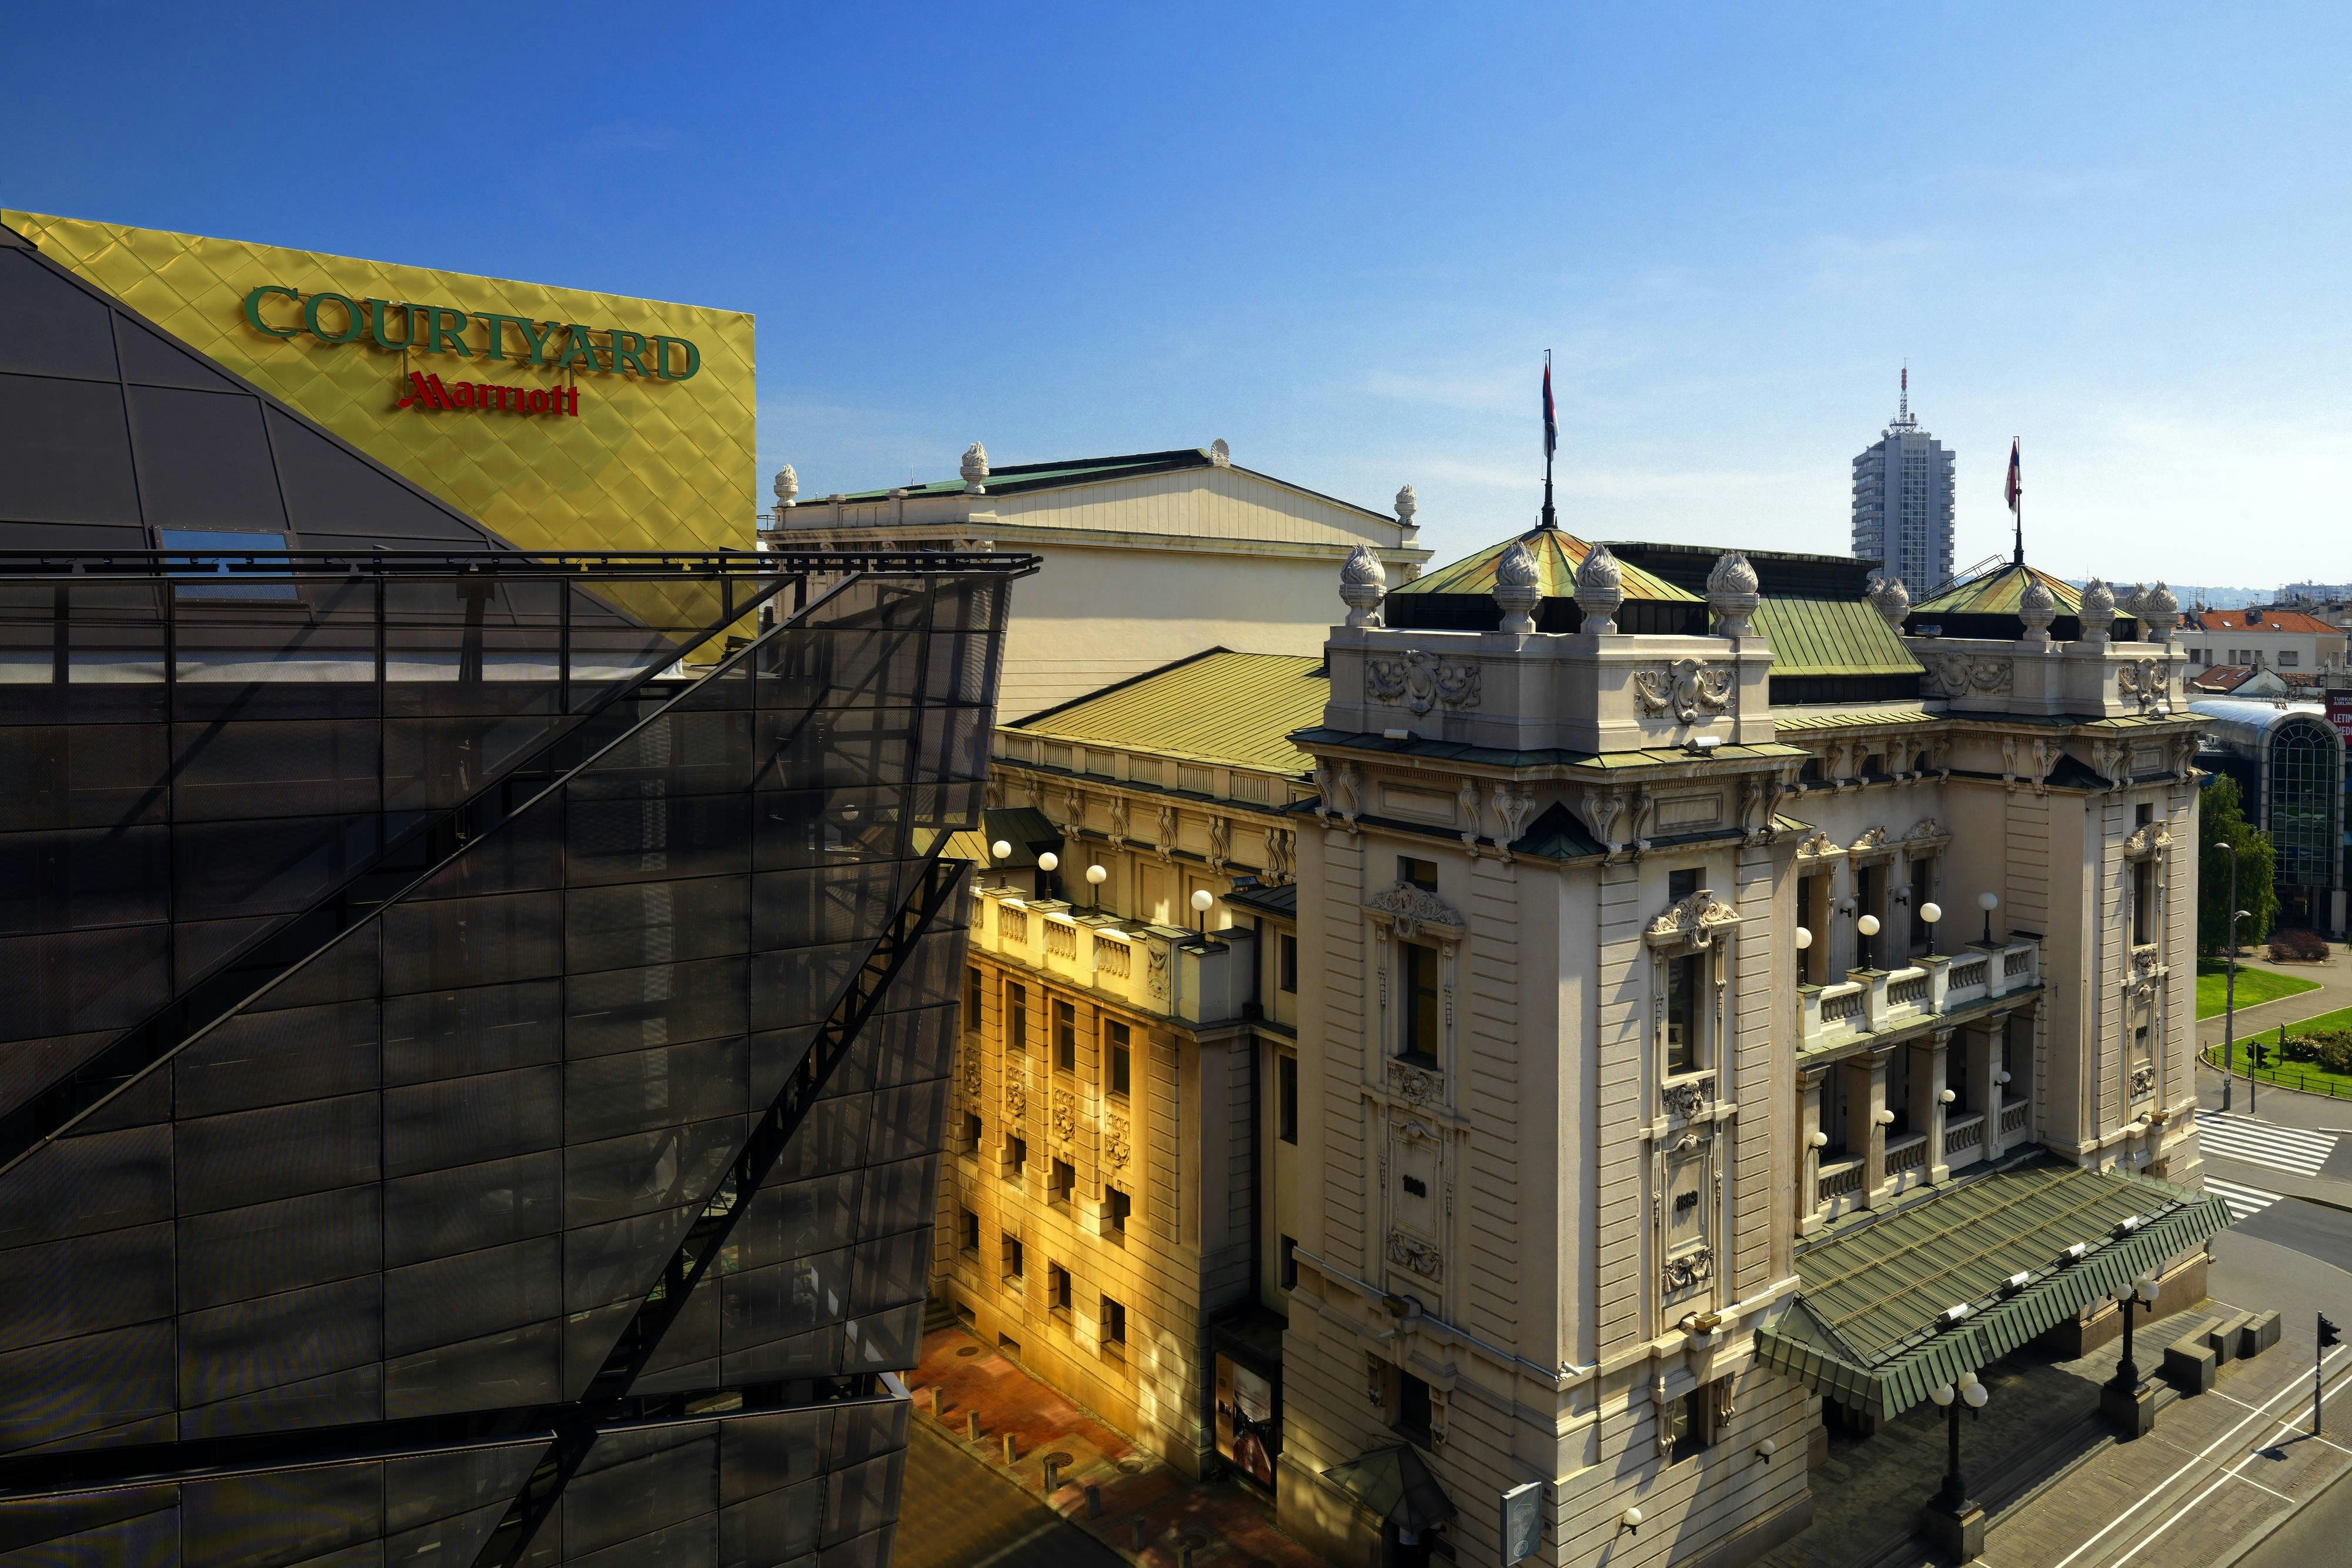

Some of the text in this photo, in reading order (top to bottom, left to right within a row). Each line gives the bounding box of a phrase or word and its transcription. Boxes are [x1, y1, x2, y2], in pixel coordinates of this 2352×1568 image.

[244, 286, 700, 381] COURTYARD
[396, 370, 580, 416] Marriott
[1676, 1190, 1698, 1211] 1869
